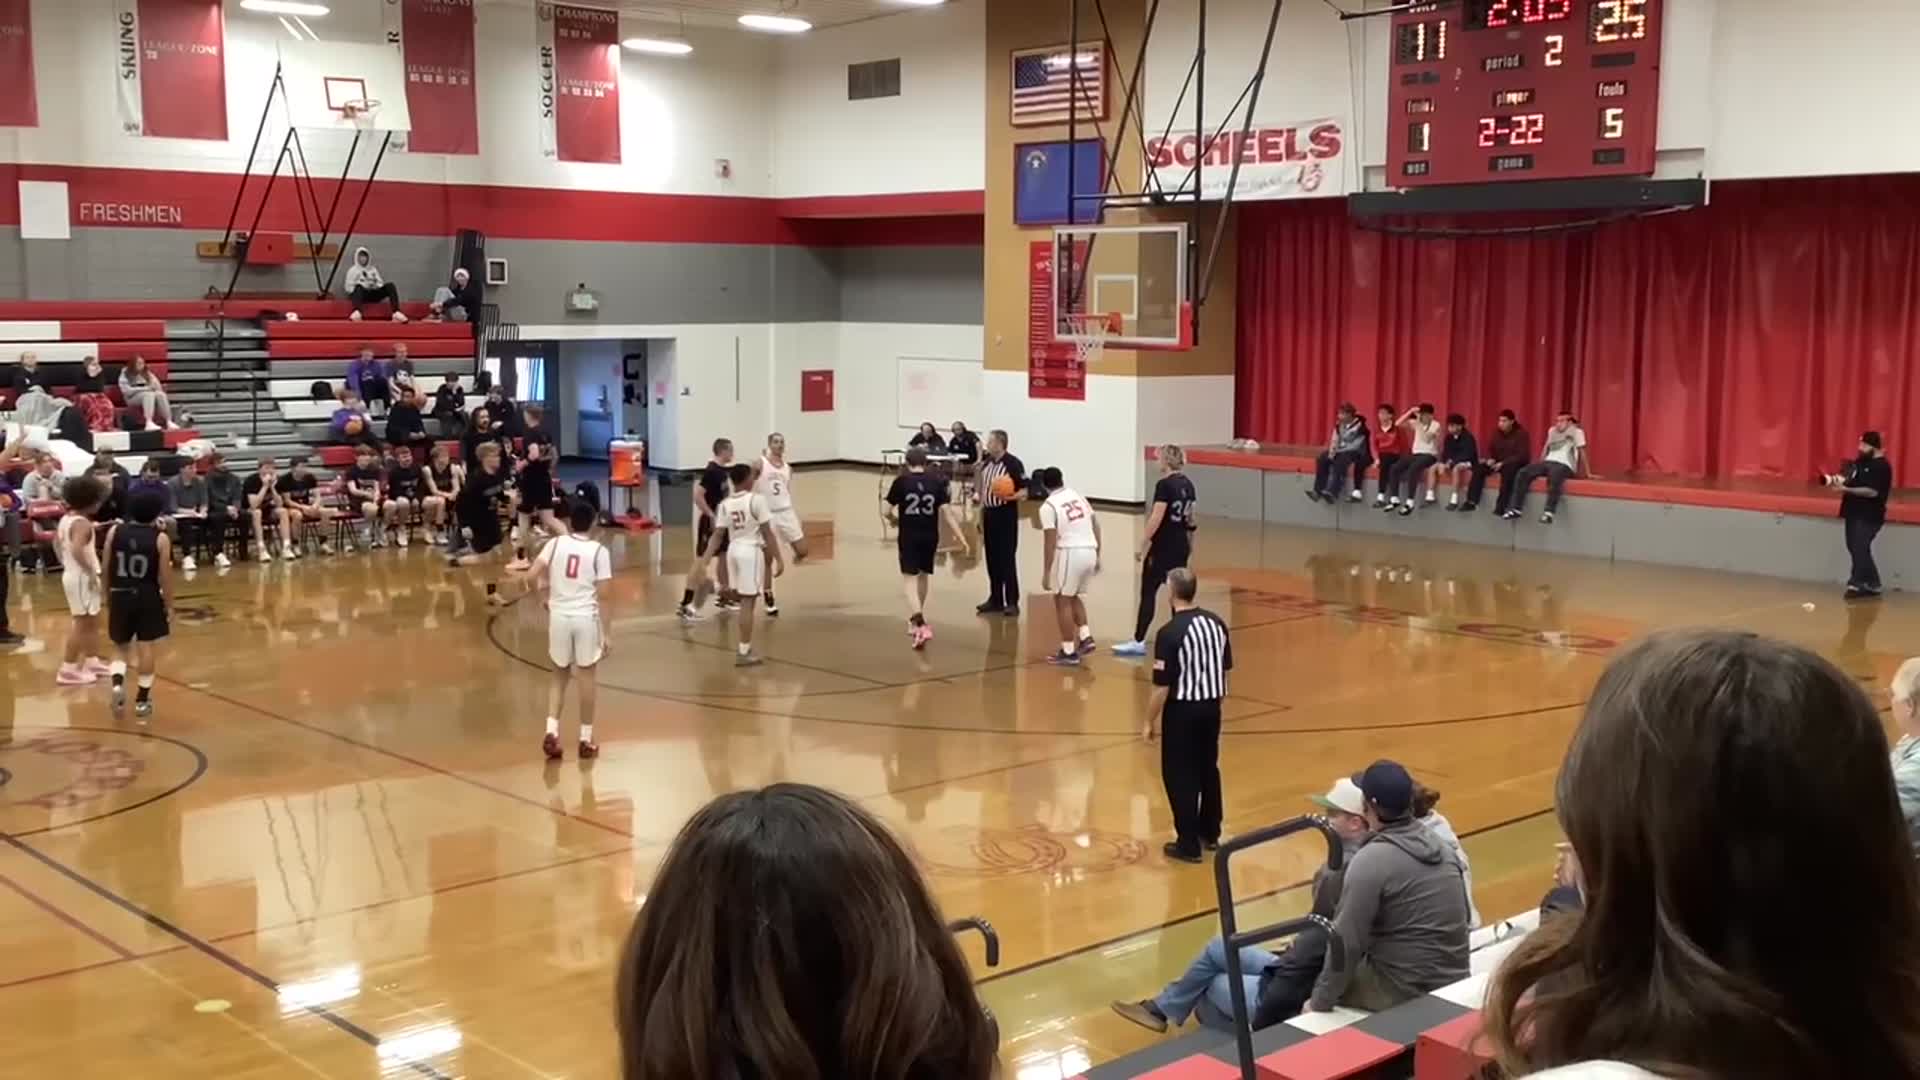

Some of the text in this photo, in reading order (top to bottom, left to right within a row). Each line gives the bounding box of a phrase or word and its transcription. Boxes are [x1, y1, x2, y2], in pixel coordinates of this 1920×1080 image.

[120, 12, 136, 80] SKIING
[1417, 20, 1447, 61] 11
[1545, 35, 1563, 67] 2
[1486, 54, 1519, 71] period
[541, 46, 553, 118] SOCCER
[1479, 113, 1544, 147] 2-22
[1604, 108, 1624, 138] 5
[1147, 124, 1341, 168] SCHEELS
[80, 203, 182, 223] FRESHMEN
[773, 483, 781, 496] 5
[904, 493, 936, 515] 23
[1061, 500, 1085, 521] 25
[116, 551, 149, 579] 10
[566, 554, 580, 579] 0
